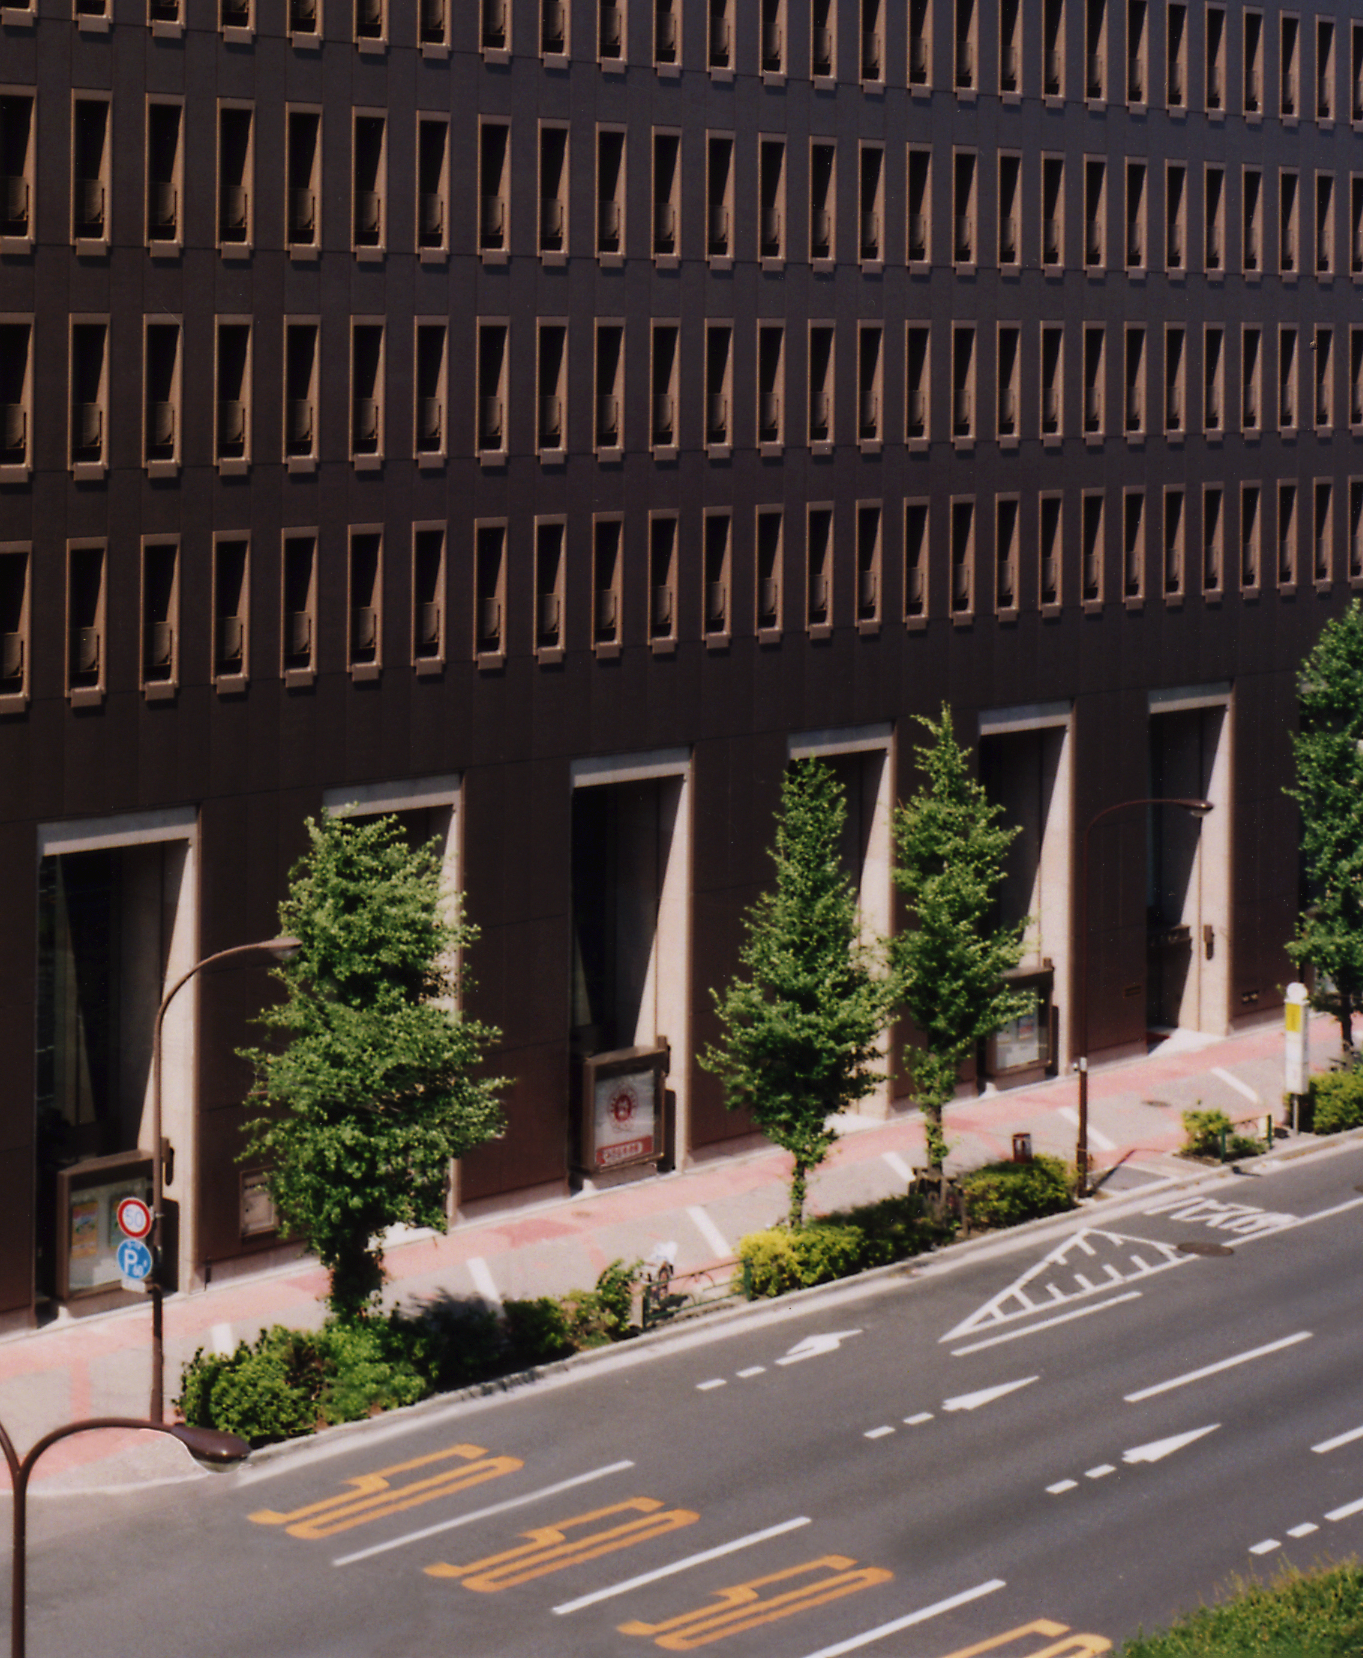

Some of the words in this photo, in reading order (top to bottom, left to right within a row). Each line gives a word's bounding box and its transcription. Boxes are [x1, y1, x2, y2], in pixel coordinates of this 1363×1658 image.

[125, 1207, 144, 1228] 50
[247, 1443, 524, 1539] 50
[424, 1496, 700, 1592] 50
[615, 1553, 895, 1650] 50
